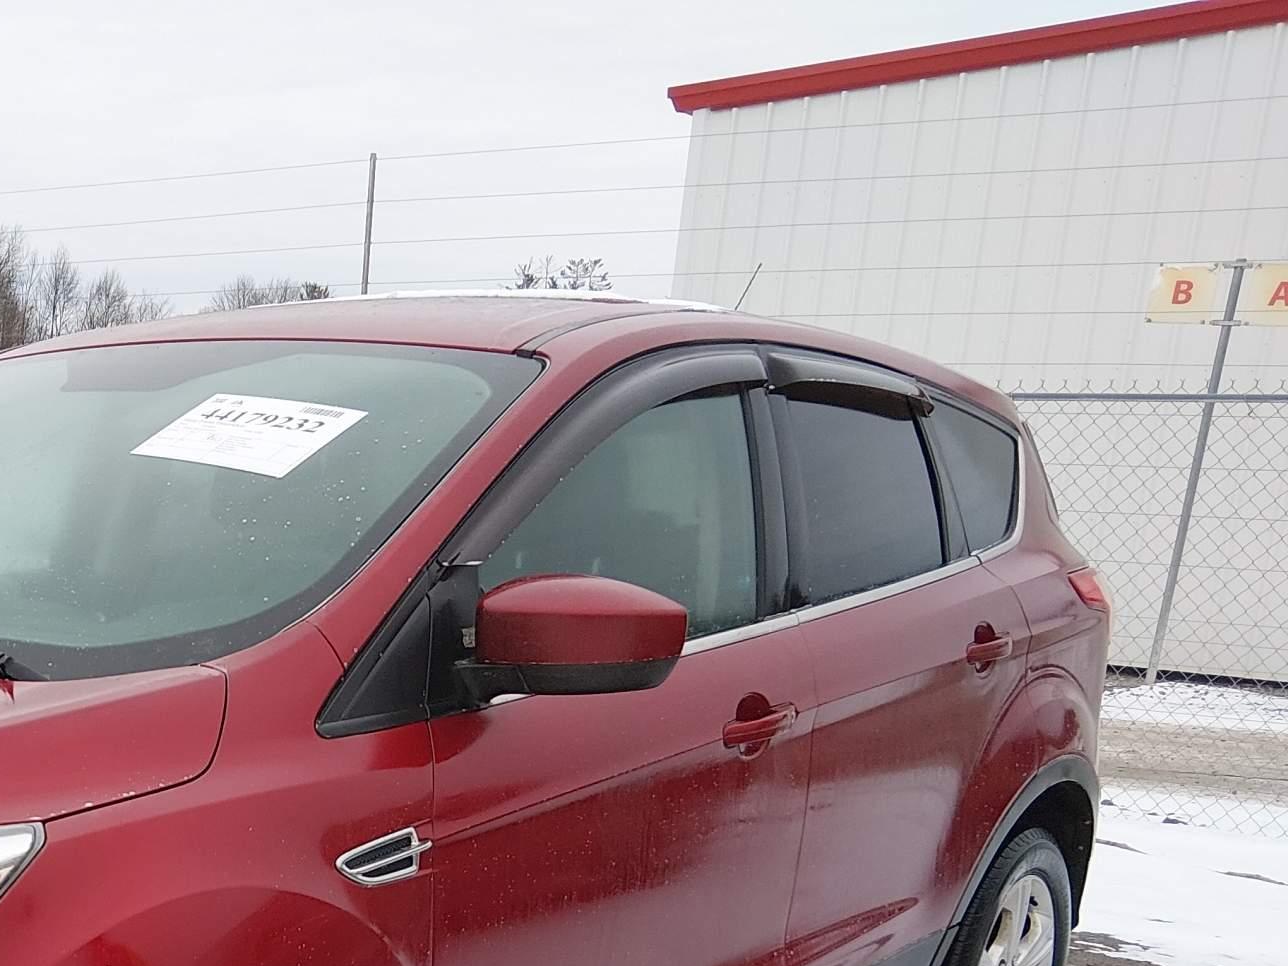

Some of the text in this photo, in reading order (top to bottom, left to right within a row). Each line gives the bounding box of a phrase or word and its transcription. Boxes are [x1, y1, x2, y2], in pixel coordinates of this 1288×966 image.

[1172, 280, 1193, 304] B
[1268, 281, 1288, 306] A
[200, 408, 325, 433] 44179232
